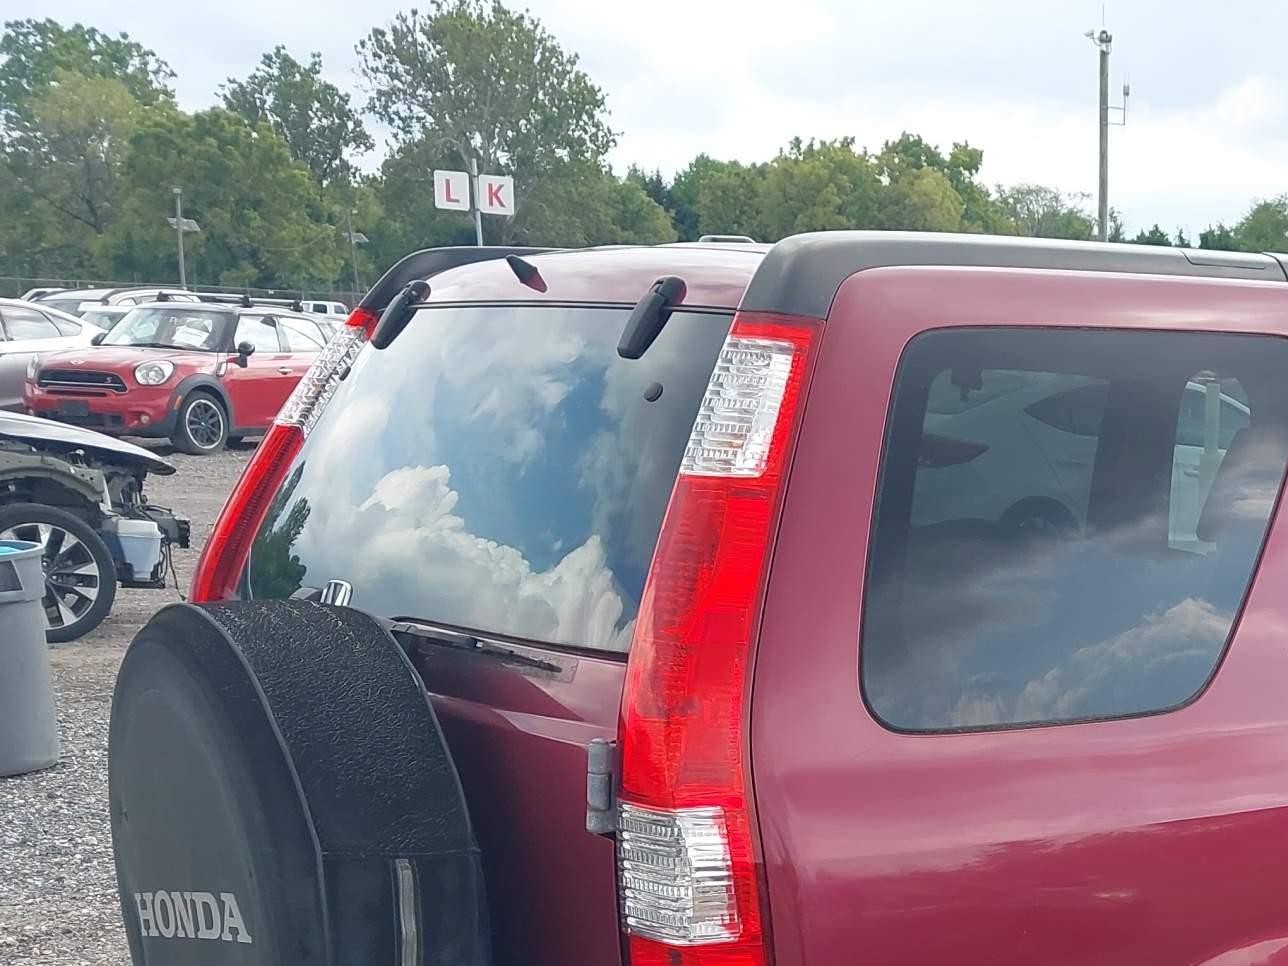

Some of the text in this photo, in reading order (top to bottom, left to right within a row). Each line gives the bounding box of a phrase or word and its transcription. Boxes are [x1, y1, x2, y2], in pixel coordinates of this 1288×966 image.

[445, 178, 460, 204] L
[487, 182, 506, 209] K
[134, 889, 252, 943] HONDA
